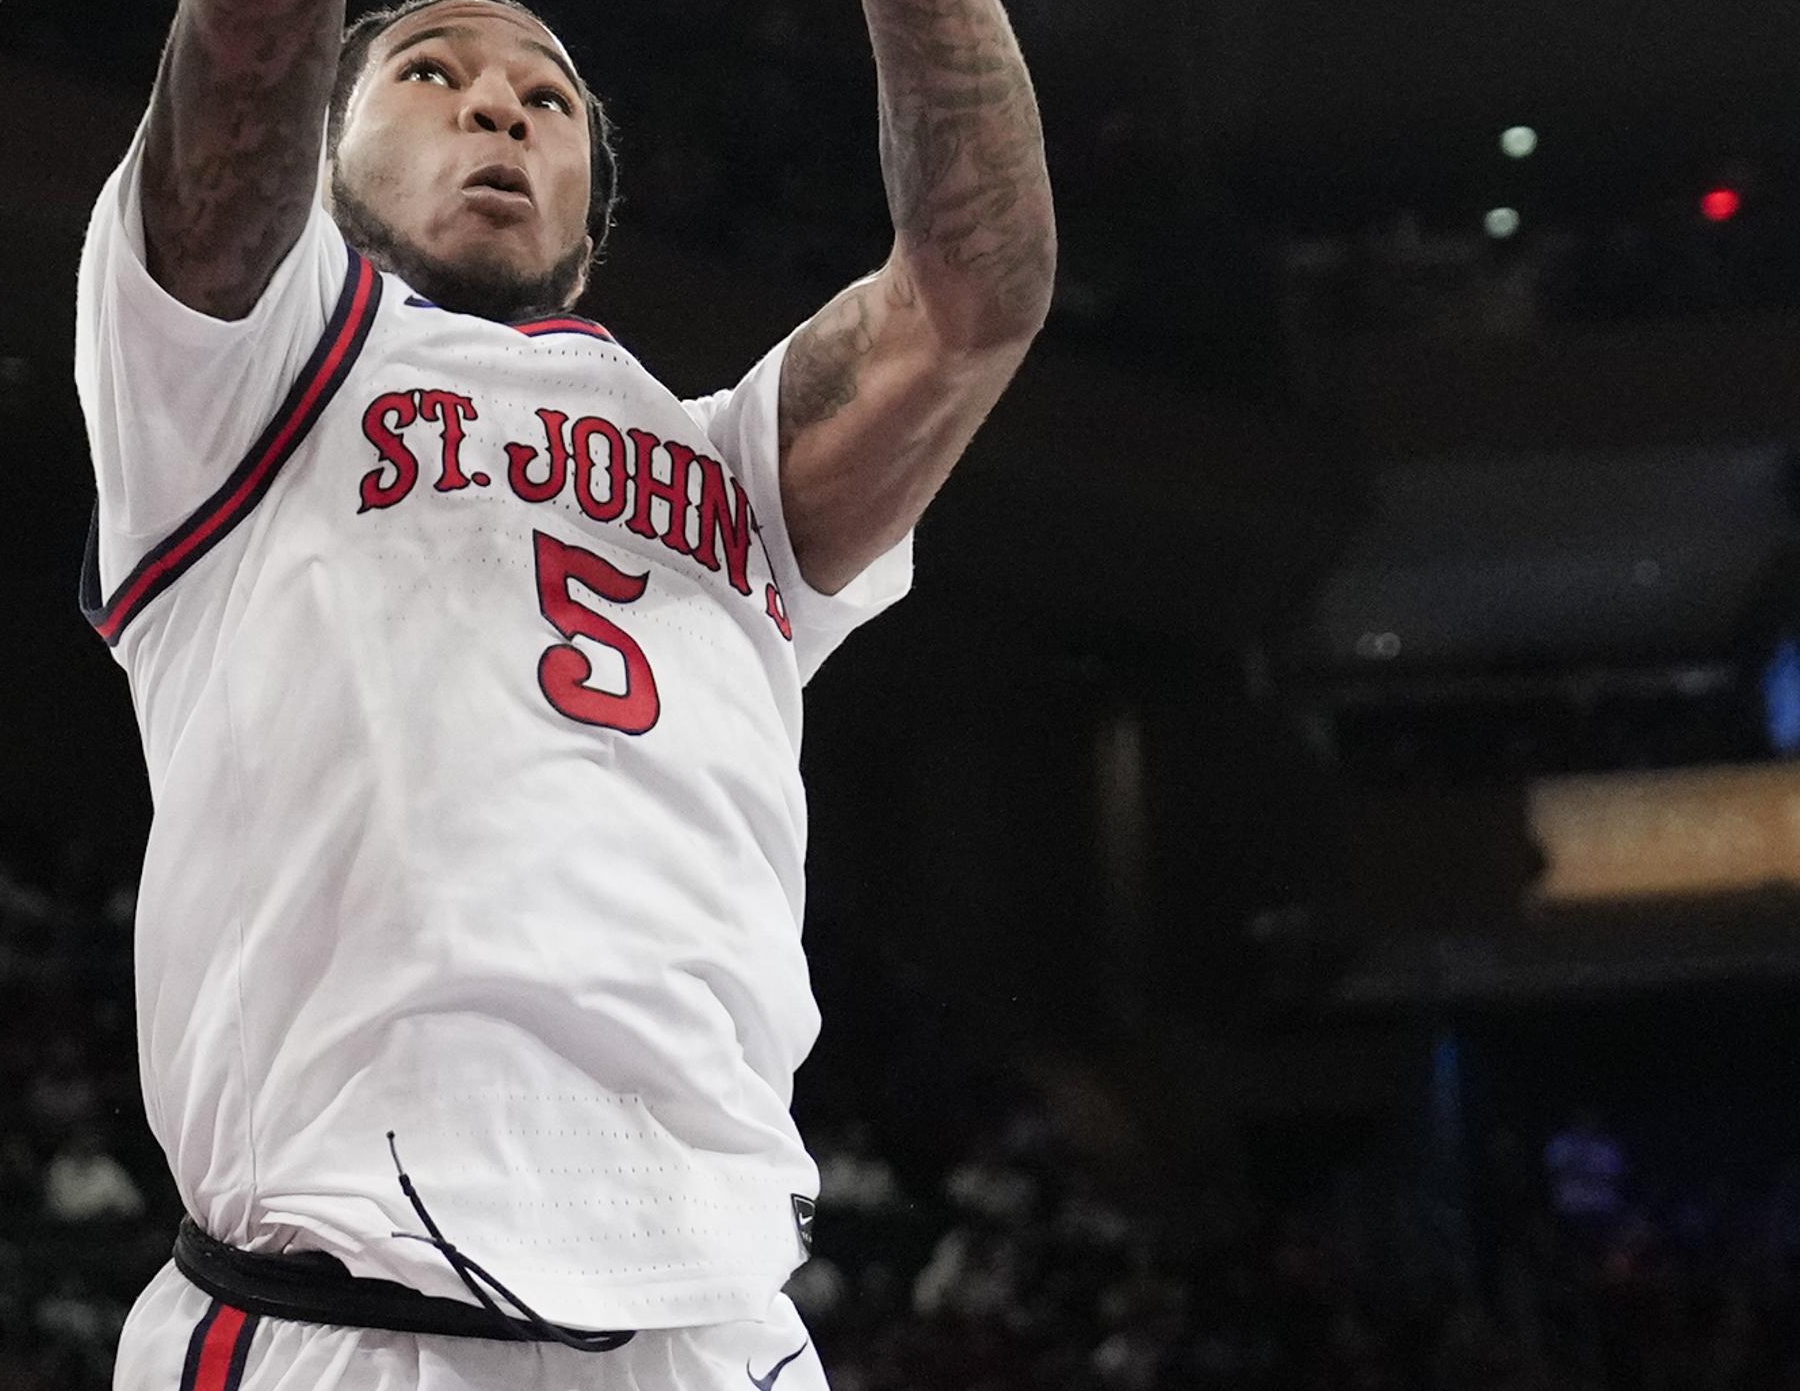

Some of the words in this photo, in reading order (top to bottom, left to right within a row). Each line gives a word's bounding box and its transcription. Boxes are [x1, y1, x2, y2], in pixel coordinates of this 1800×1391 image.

[357, 388, 492, 515] ST.
[504, 408, 792, 641] JOHN
[532, 528, 661, 736] 5
